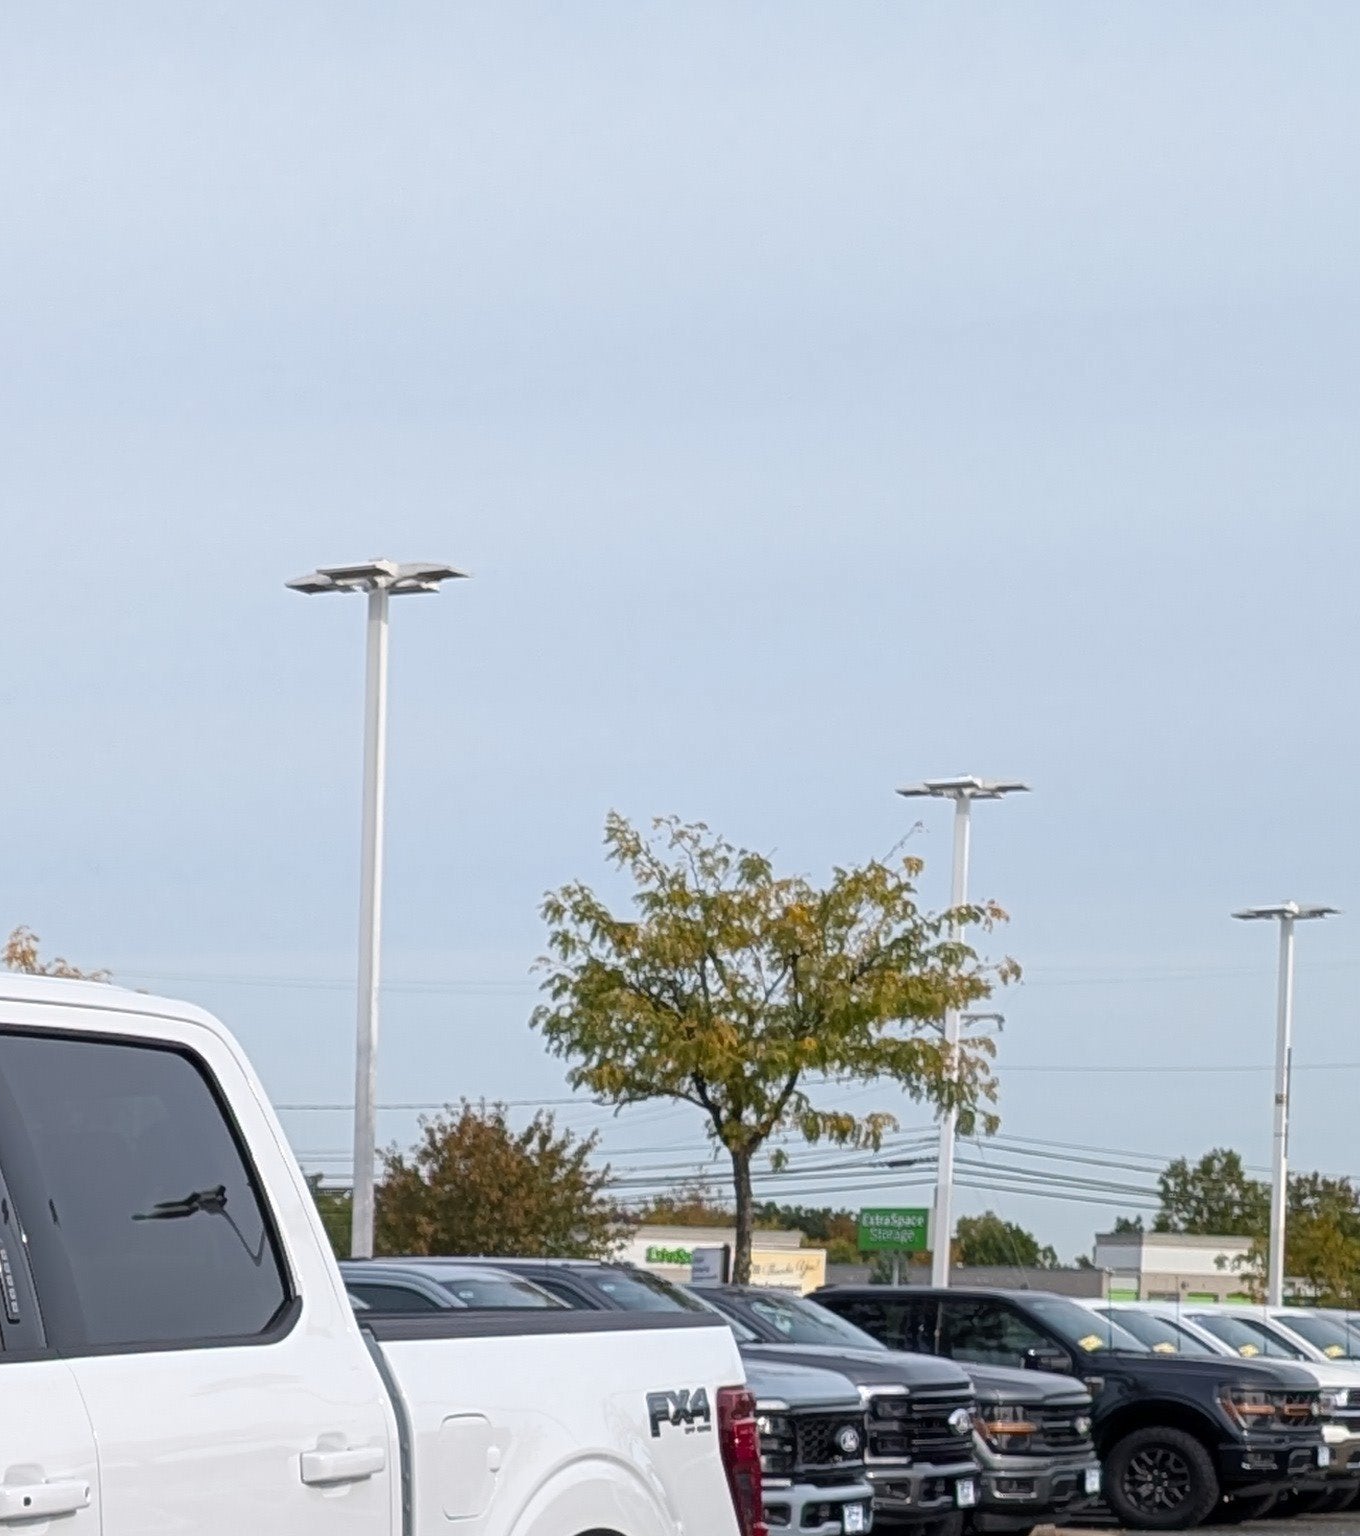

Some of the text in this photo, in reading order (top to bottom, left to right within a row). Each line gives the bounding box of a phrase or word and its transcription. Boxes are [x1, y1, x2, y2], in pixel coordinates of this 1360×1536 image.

[862, 1213, 924, 1228] ExtraSpace
[870, 1228, 915, 1243] Storage
[646, 1387, 711, 1438] FX4
